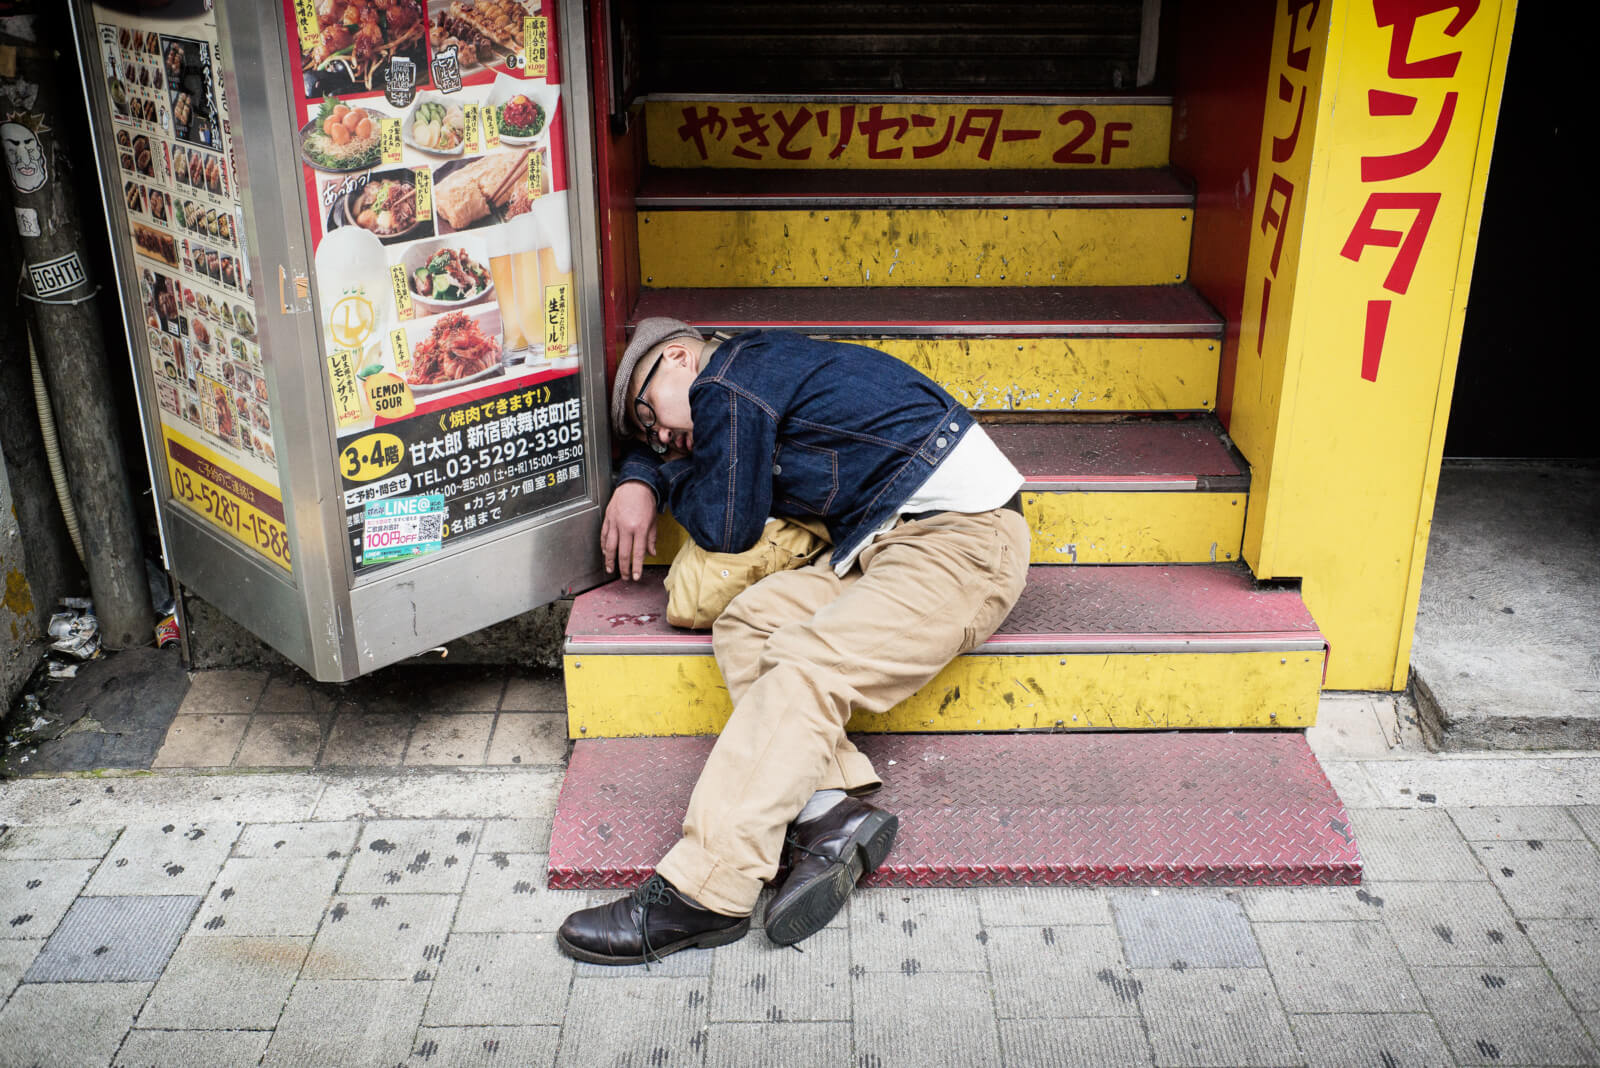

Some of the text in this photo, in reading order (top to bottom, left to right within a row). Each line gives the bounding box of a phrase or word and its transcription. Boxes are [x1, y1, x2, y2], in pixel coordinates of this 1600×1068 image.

[678, 105, 1133, 165] やきとりセンター 2F
[32, 258, 84, 292] EIGHTH
[548, 297, 560, 343] 生ビール
[331, 357, 348, 412] レモンサワー
[371, 382, 405, 400] LEMON
[375, 395, 403, 412] SOUR
[409, 398, 580, 467] 甘太郎 新宿歌舞伎町店
[346, 479, 409, 504] ご予約・問合せ
[385, 498, 430, 515] LINE@
[175, 467, 291, 564] 03-5287-1588
[366, 530, 417, 548] 100円OFF
